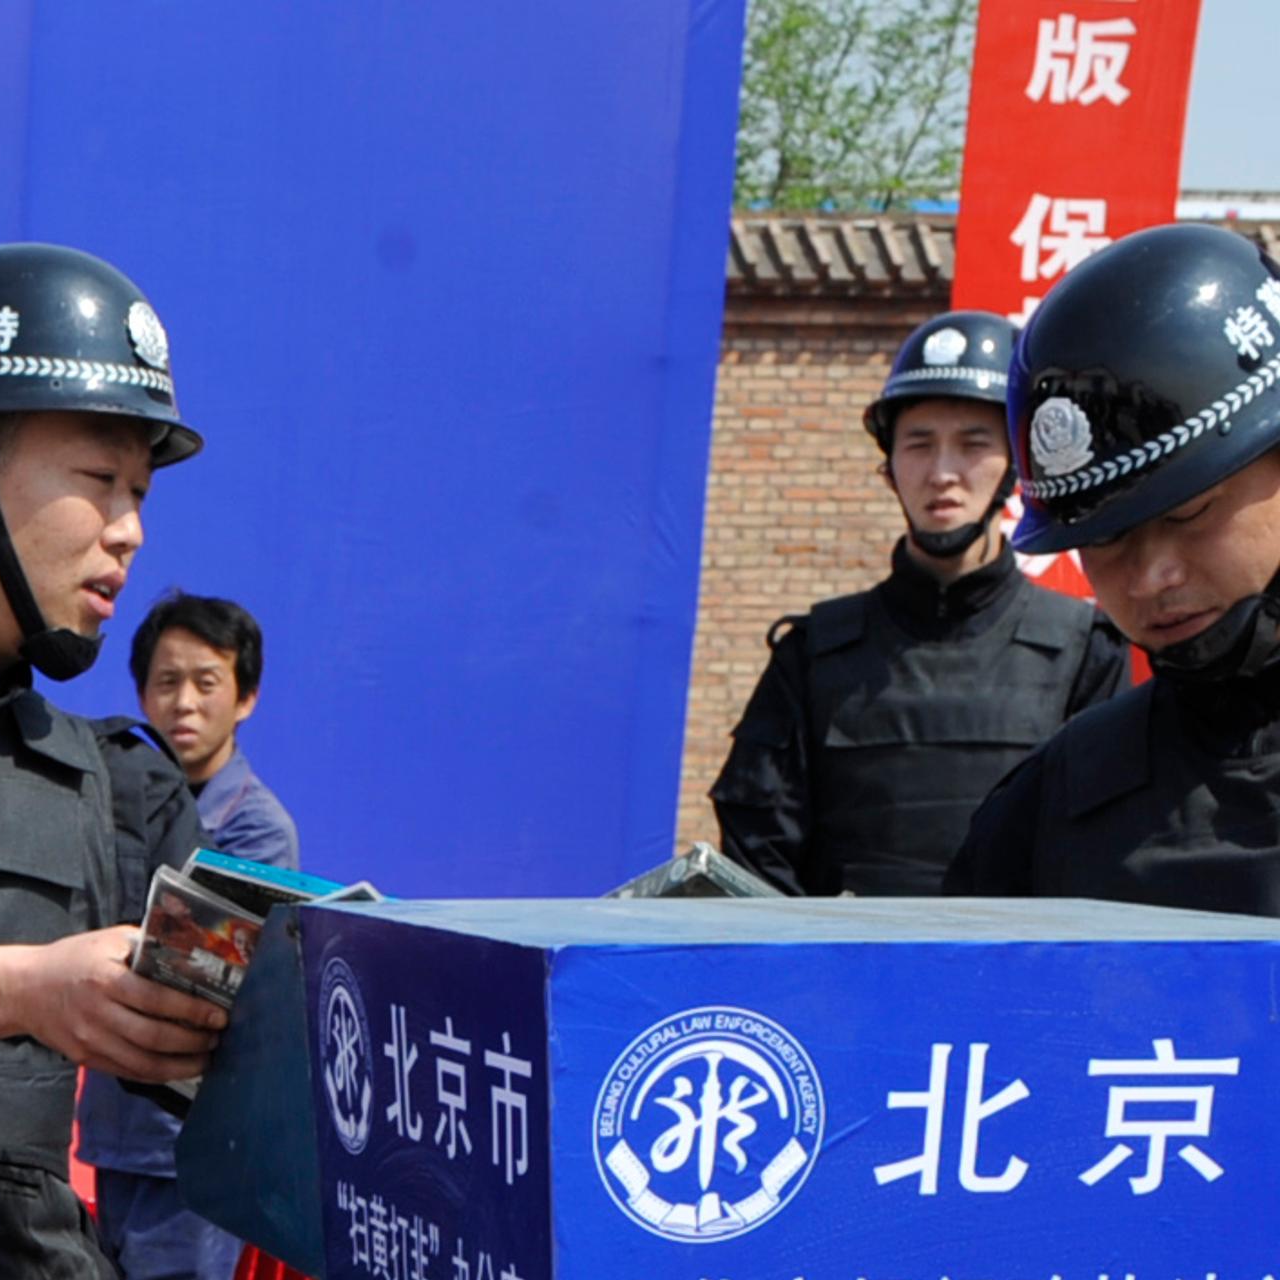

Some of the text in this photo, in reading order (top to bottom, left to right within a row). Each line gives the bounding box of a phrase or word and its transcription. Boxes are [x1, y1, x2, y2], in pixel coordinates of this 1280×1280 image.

[383, 1003, 533, 1186] 北京市
[600, 1014, 819, 1137] BEIJING CULTURAL LAW ENFORCEMENT AGENCY
